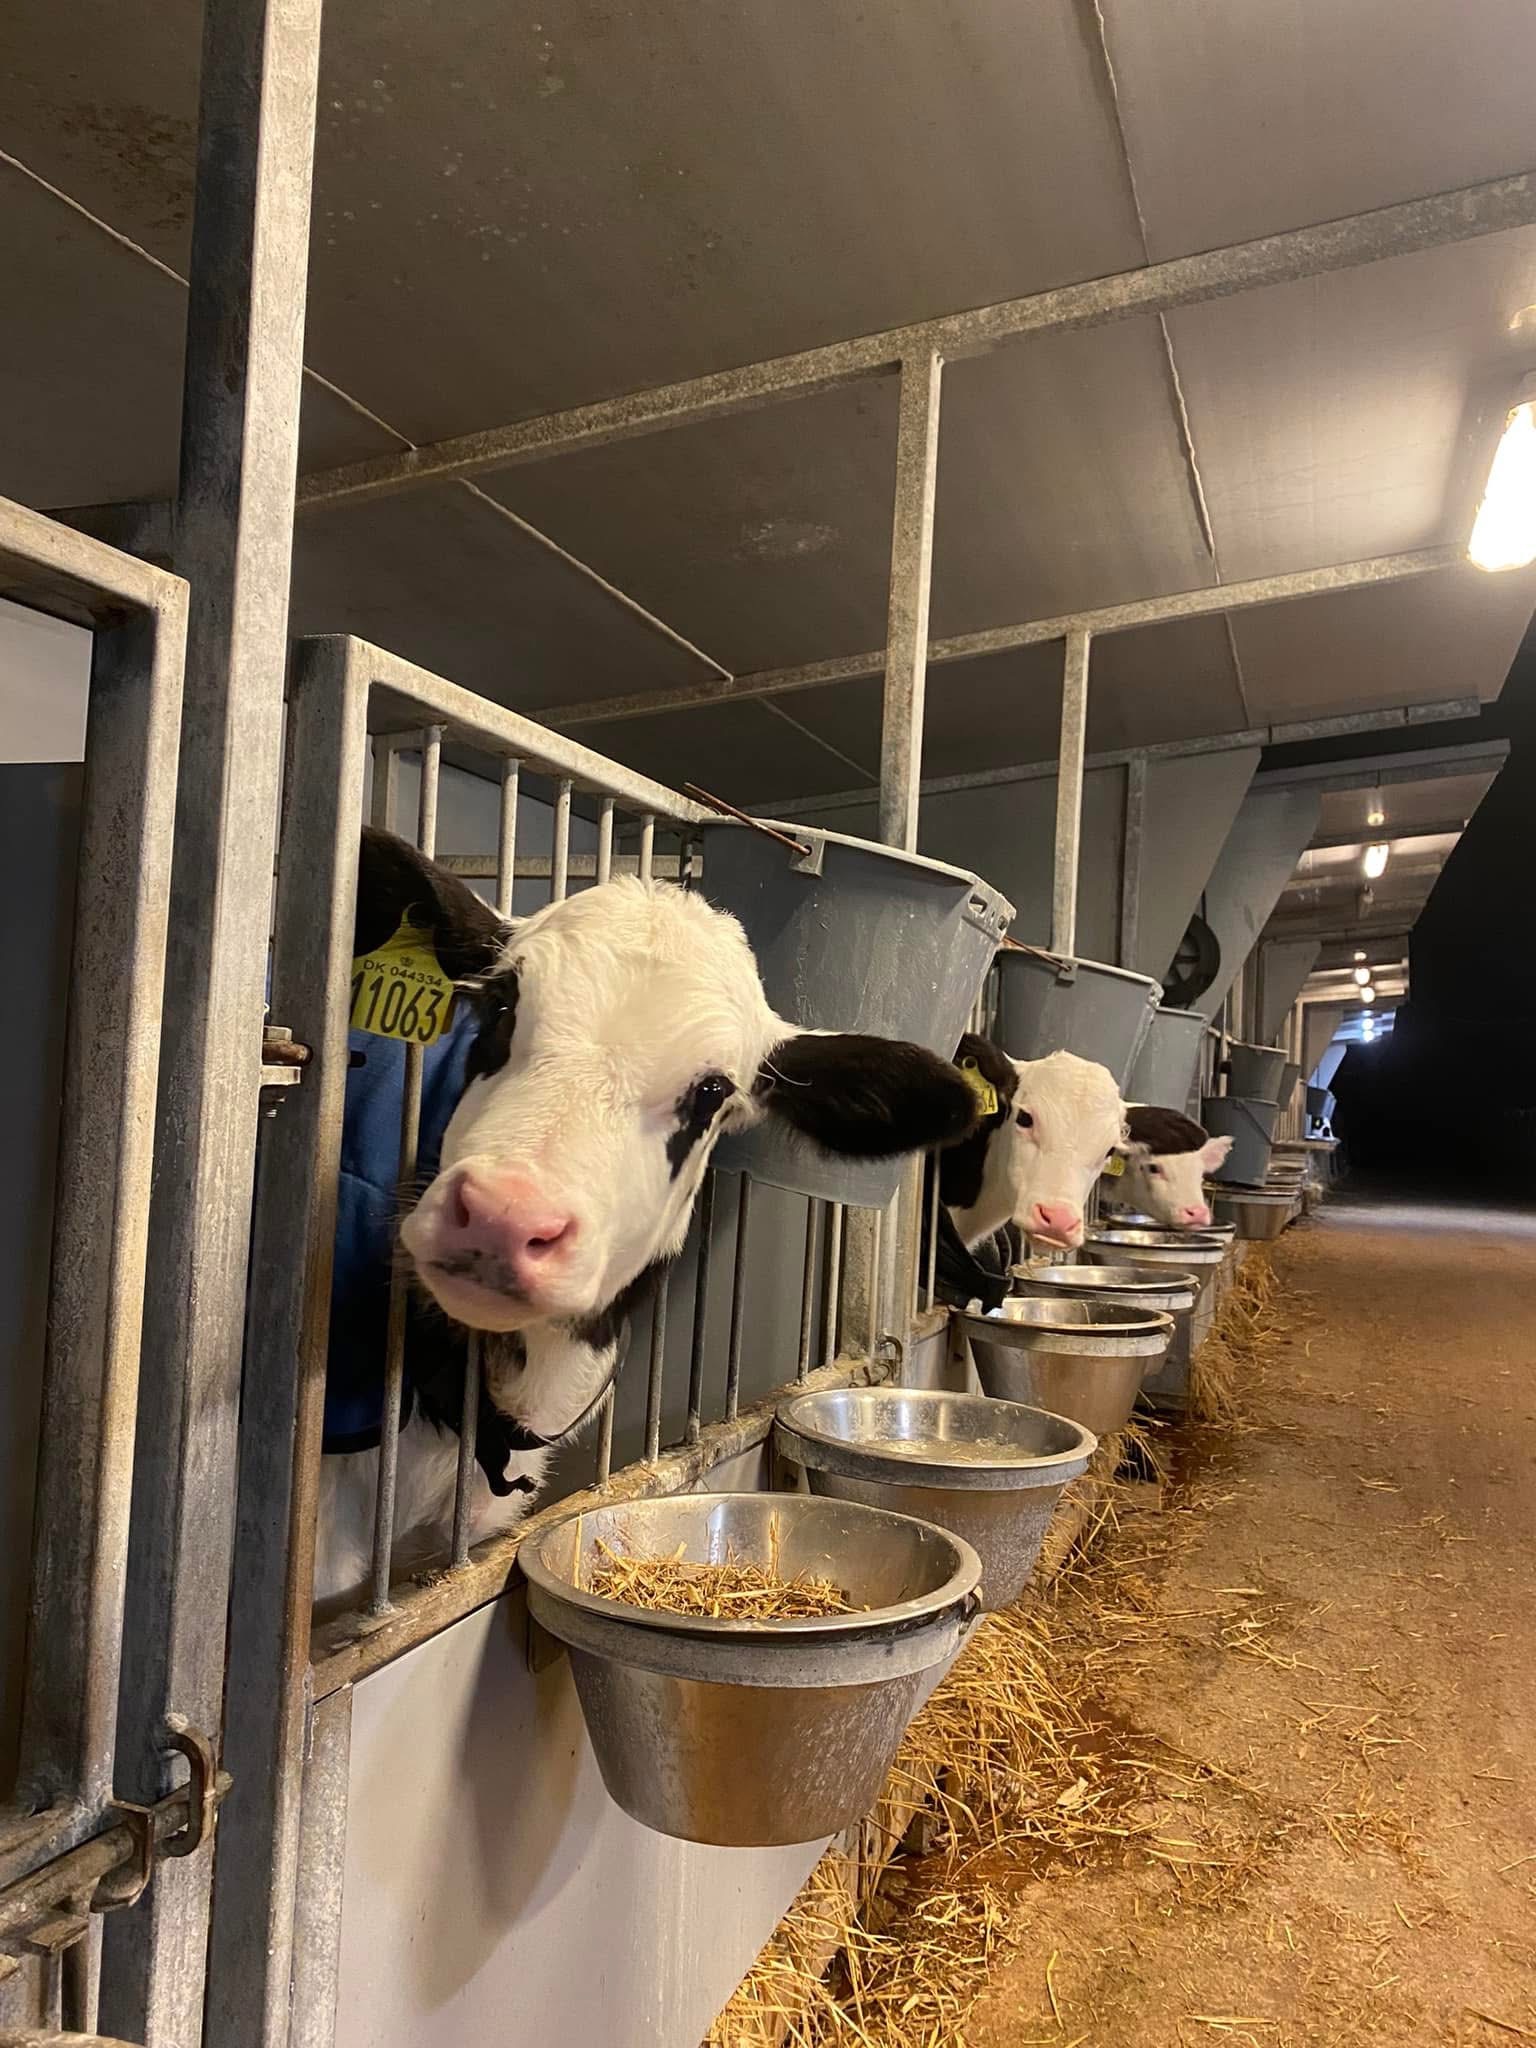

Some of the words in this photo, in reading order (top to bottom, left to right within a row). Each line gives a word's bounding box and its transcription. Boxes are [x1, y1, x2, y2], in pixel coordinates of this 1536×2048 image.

[363, 960, 386, 973] DK
[390, 966, 442, 986] 044334
[350, 971, 445, 1042] 11063
